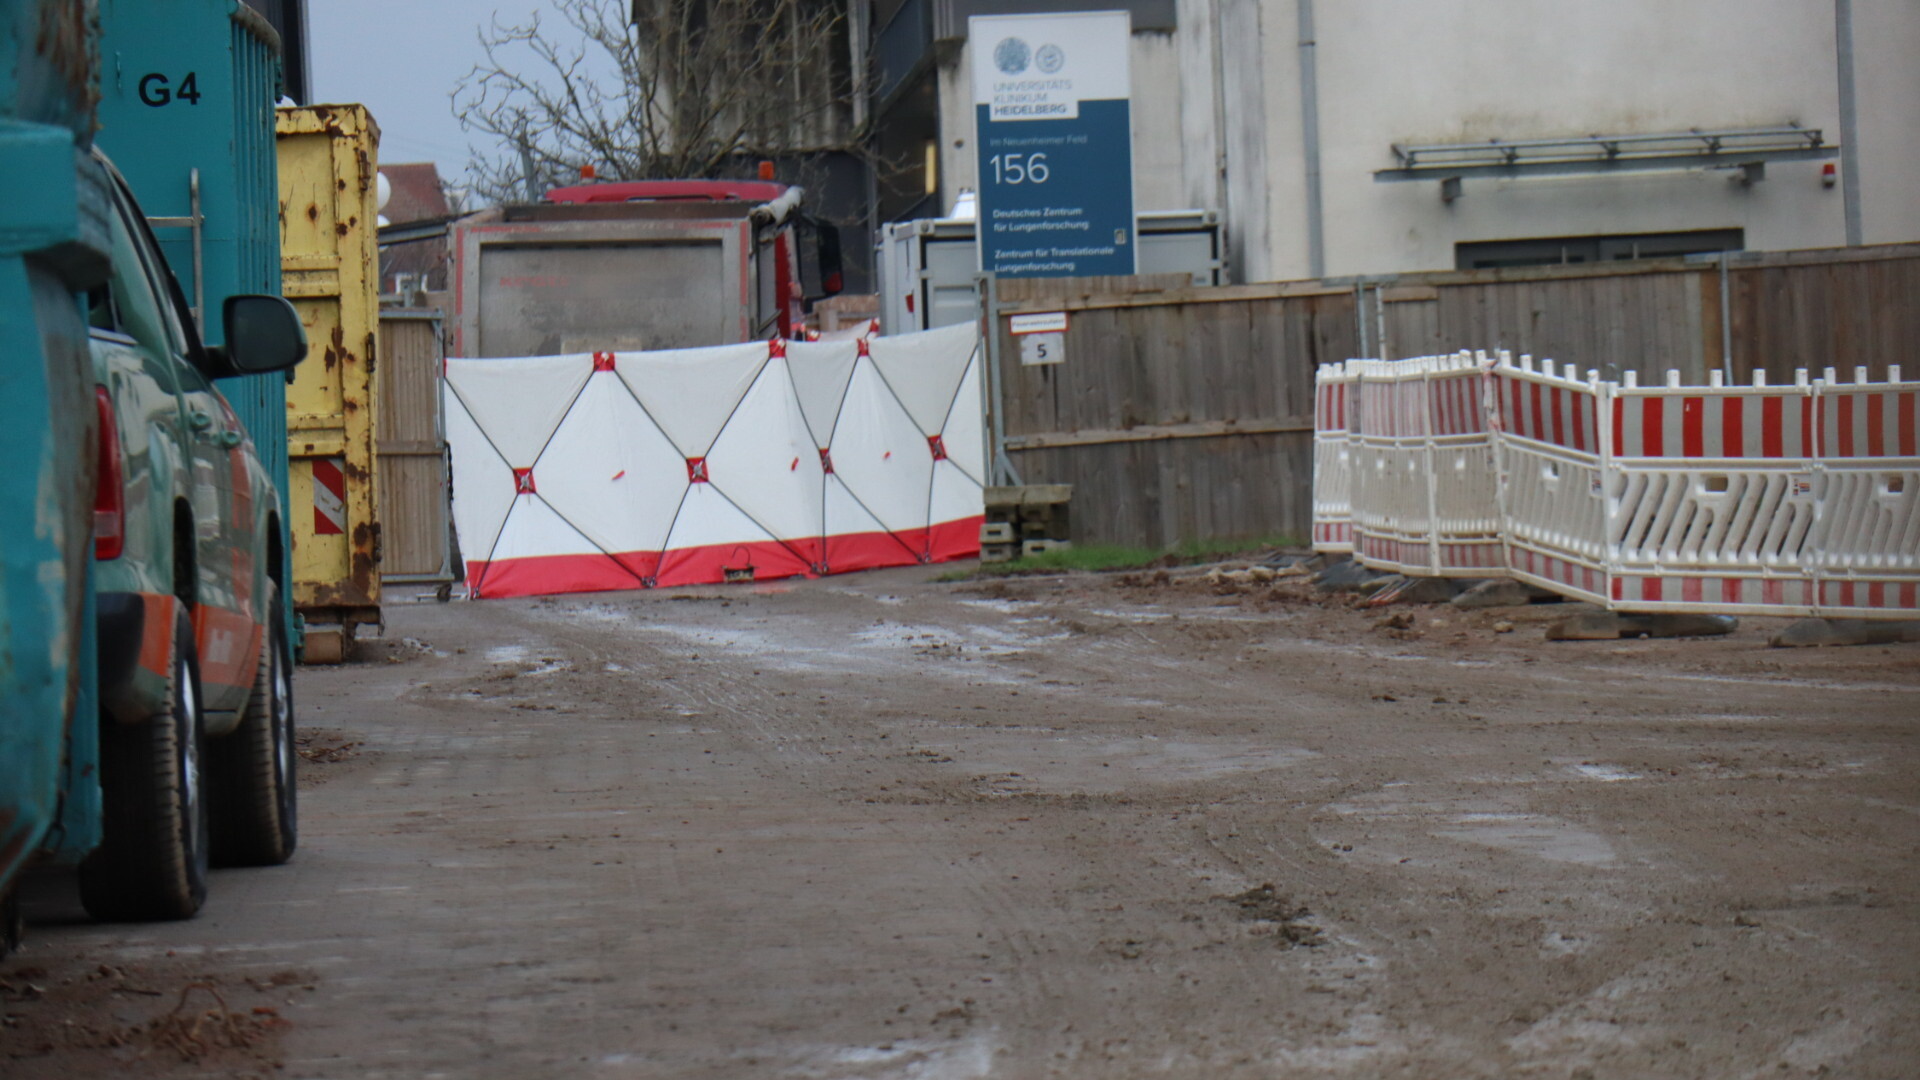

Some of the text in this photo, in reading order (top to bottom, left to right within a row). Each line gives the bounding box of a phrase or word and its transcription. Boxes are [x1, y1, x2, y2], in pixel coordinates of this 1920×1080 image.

[138, 71, 202, 108] G4
[994, 103, 1067, 116] HEIDELBERG
[989, 152, 1050, 185] 156
[993, 207, 1083, 219] Deutsches Zentrum
[1008, 221, 1090, 233] Lungenforschung
[994, 249, 1033, 259] Zentrum
[1035, 248, 1048, 257] für
[994, 262, 1075, 274] Lungenforschung
[1037, 343, 1048, 359] 5
